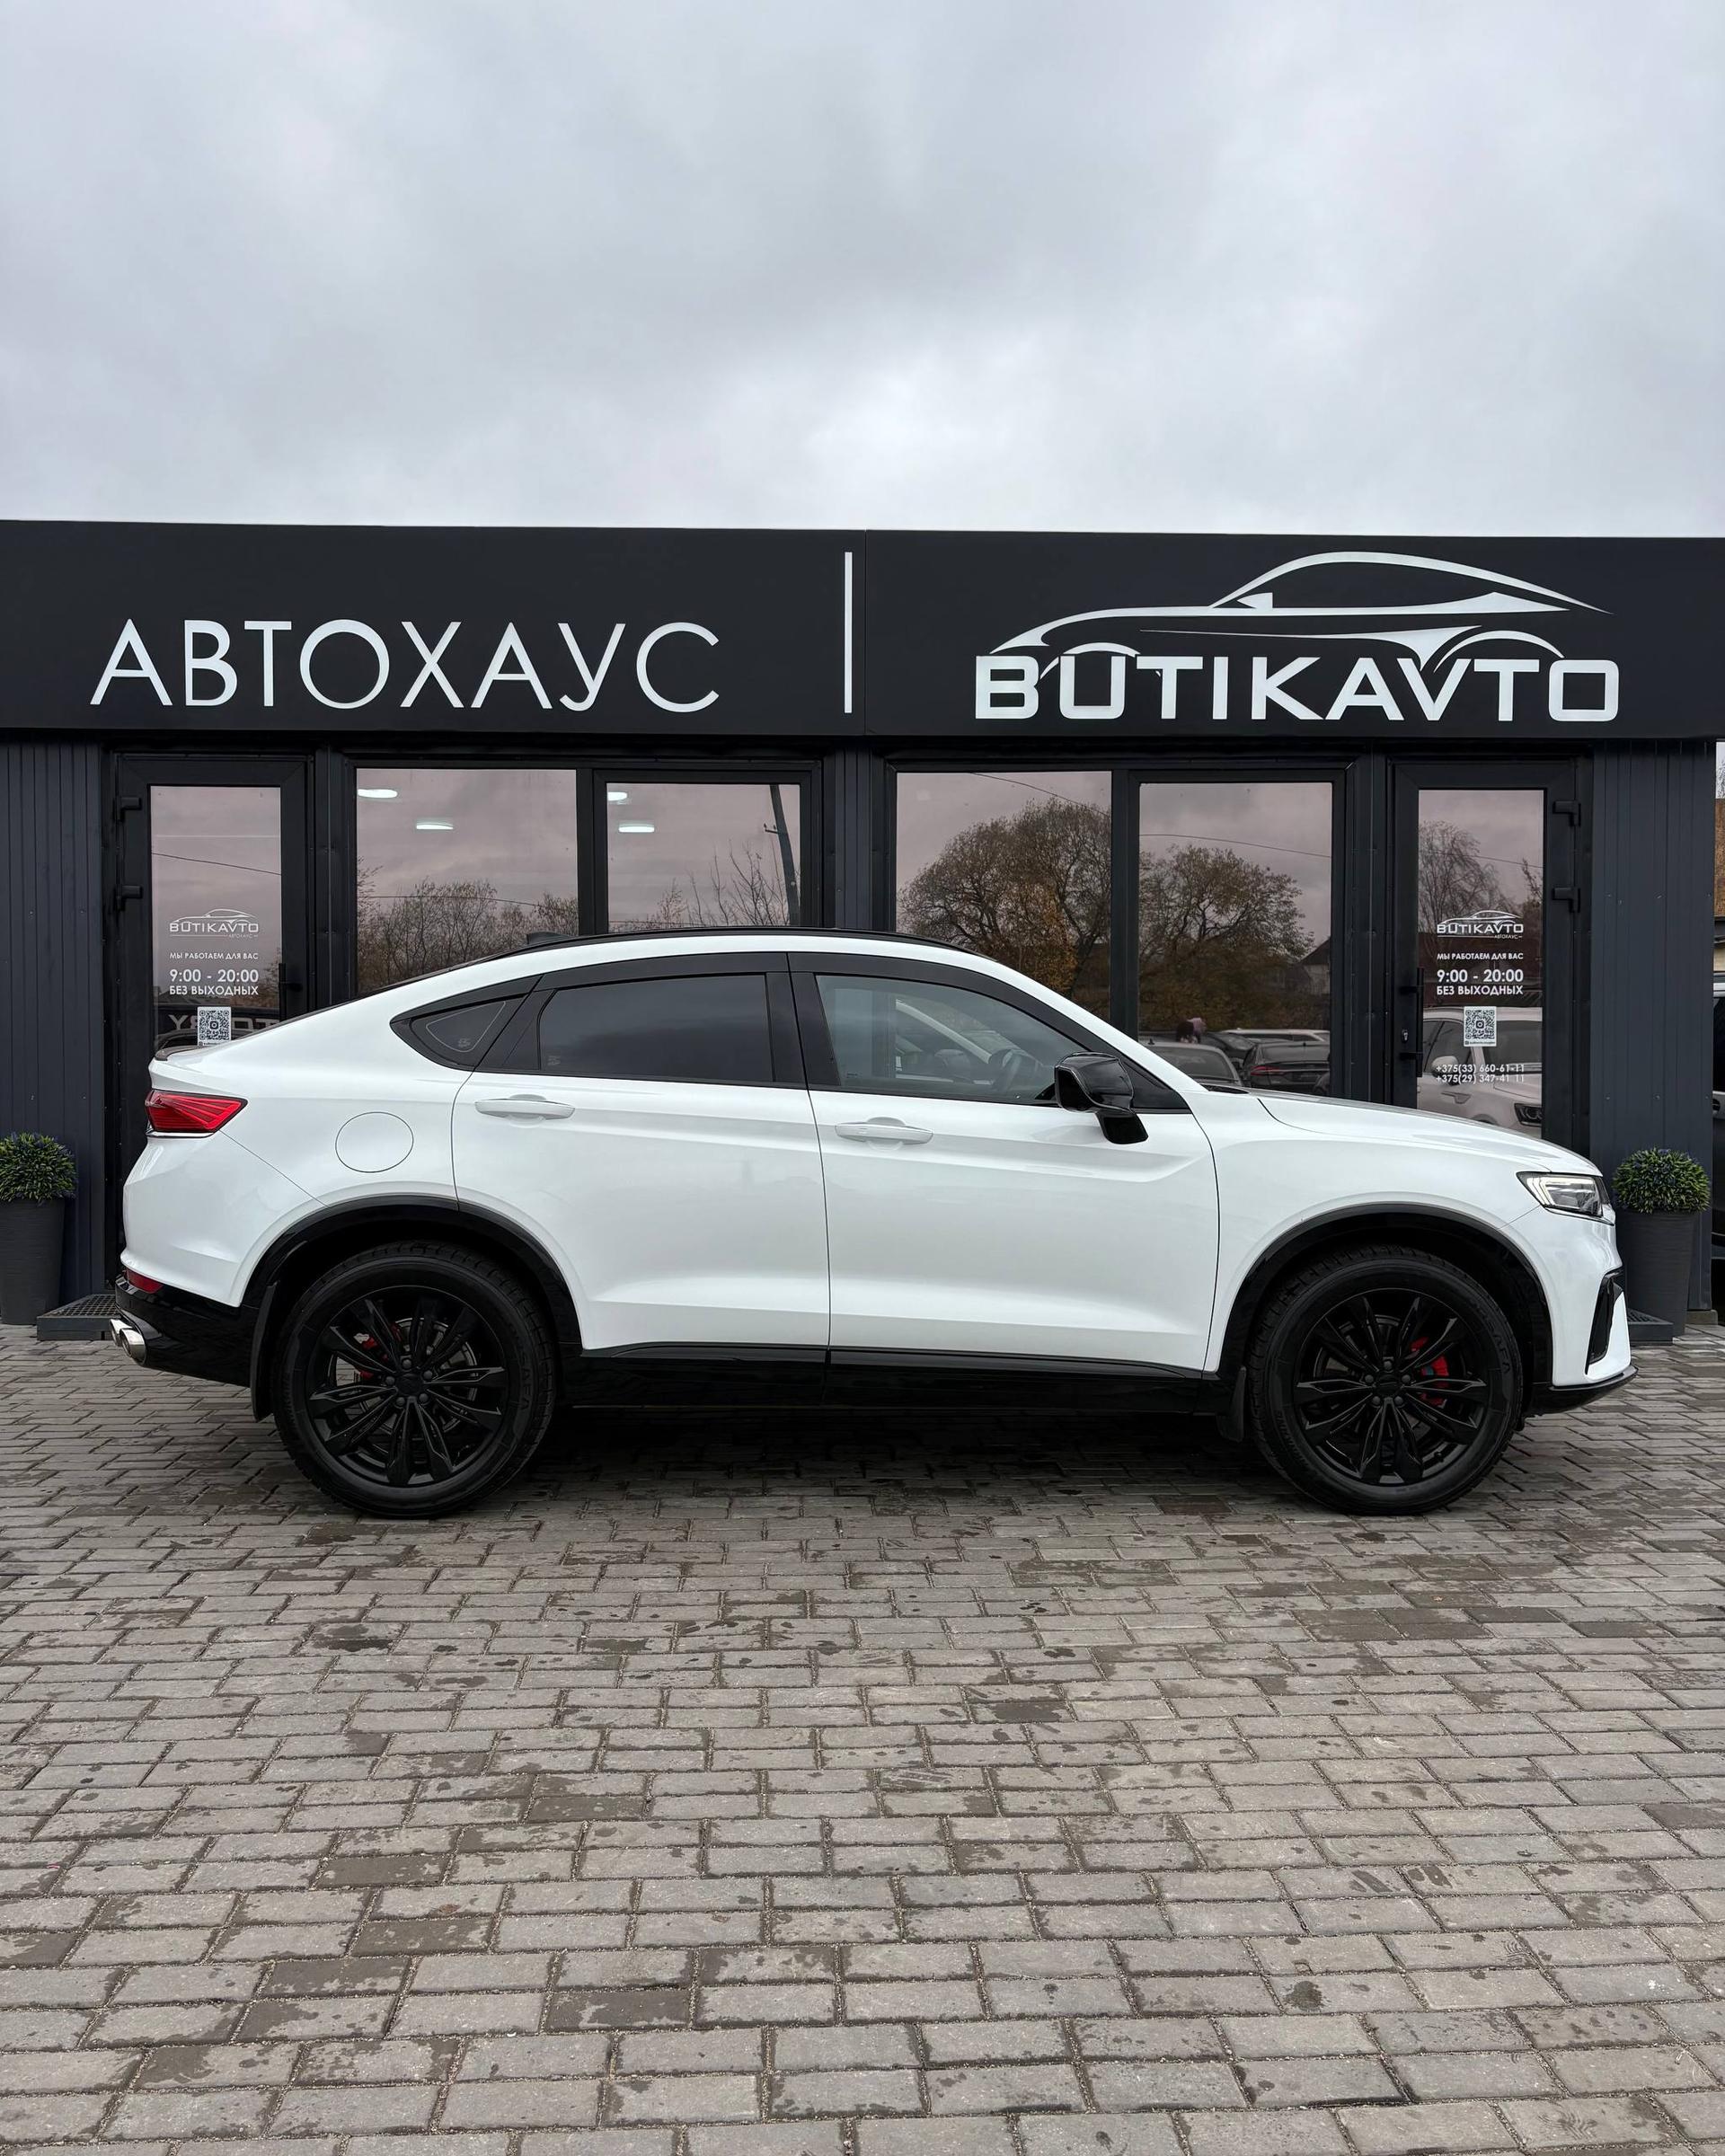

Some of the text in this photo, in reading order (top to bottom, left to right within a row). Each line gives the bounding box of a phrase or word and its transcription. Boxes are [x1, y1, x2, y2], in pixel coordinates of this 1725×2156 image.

[90, 618, 720, 712] АВТОХАУС
[975, 655, 1620, 722] BUTIKAVTO
[169, 923, 259, 932] BUTIKAVTO
[1437, 923, 1524, 933] BUTIKAVTO
[170, 969, 201, 982] 9:00
[217, 969, 259, 982] 20:00
[1438, 969, 1468, 982] 9:00
[1483, 969, 1524, 982] 20:00
[170, 985, 259, 996] БЕЗ ВЫХОДНЫХ
[1438, 985, 1523, 996] БЕЗ ВЫХОДНЫХ
[1437, 1064, 1525, 1074] +375(33) 660-61-11
[1437, 1074, 1525, 1084] +375(29) 347-4111
